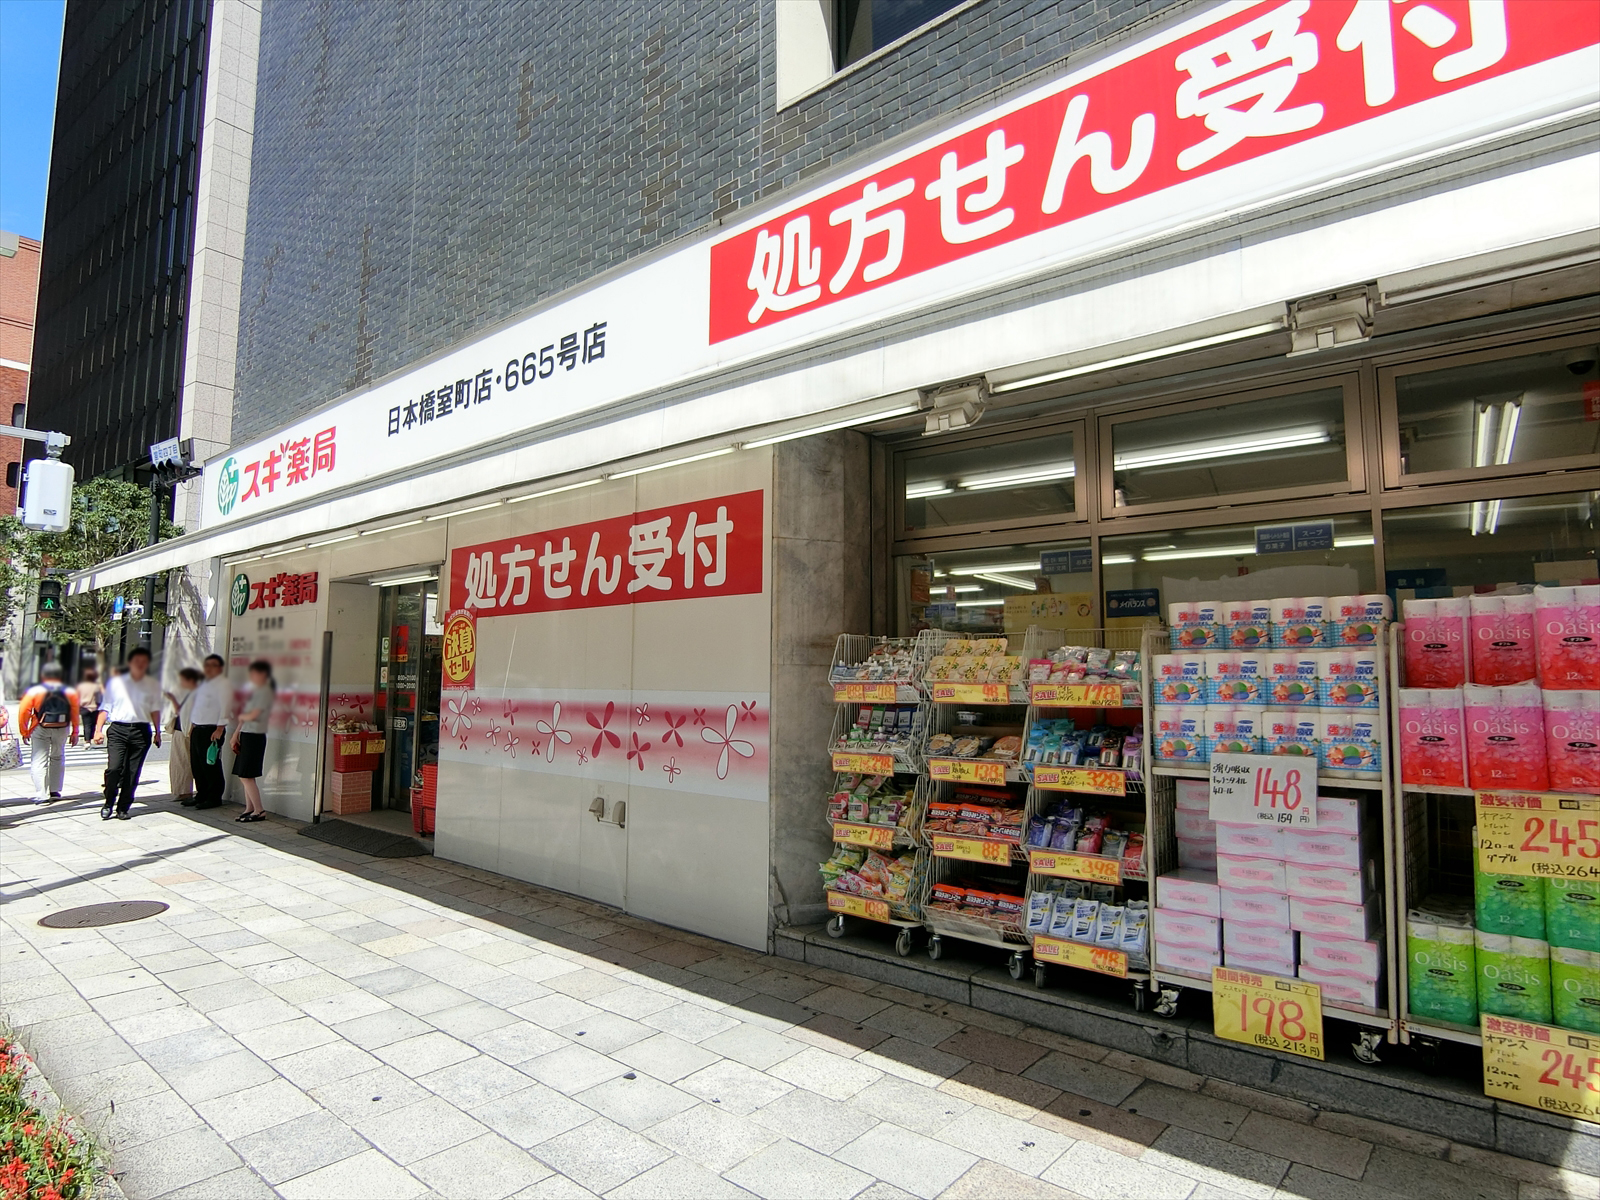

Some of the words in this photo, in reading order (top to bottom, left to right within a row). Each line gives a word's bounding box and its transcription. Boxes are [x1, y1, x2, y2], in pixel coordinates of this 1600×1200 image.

[748, 0, 1508, 325] 処方せん受付
[242, 426, 337, 502] スギ薬局
[464, 506, 734, 609] 処方せん受付
[249, 571, 319, 610] スギ薬局
[1411, 628, 1461, 642] Oasis
[1478, 626, 1532, 641] Oasis
[447, 627, 474, 660] 決算
[449, 655, 470, 676] セール
[936, 688, 954, 698] SALE
[1035, 690, 1056, 700] SALE
[1406, 720, 1459, 735] Oasis
[1473, 719, 1530, 735] Oasis
[974, 764, 999, 780] 138
[1036, 773, 1059, 783] SALE
[1086, 770, 1121, 788] 328
[1254, 767, 1302, 810] 148
[1480, 793, 1542, 809] 激安特価
[1277, 813, 1293, 824] 159
[1520, 817, 1600, 859] 245
[935, 843, 954, 851] SALE
[982, 841, 1000, 858] 88
[1034, 859, 1055, 869] SALE
[1081, 859, 1116, 876] 398
[1036, 944, 1059, 954] SALE
[1414, 951, 1468, 972] Oasis
[1216, 968, 1262, 987] 期間特売
[1483, 964, 1541, 986] Oasis
[1241, 993, 1306, 1041] 198
[1486, 1017, 1550, 1042] 激安特価
[1283, 1040, 1307, 1054] 213
